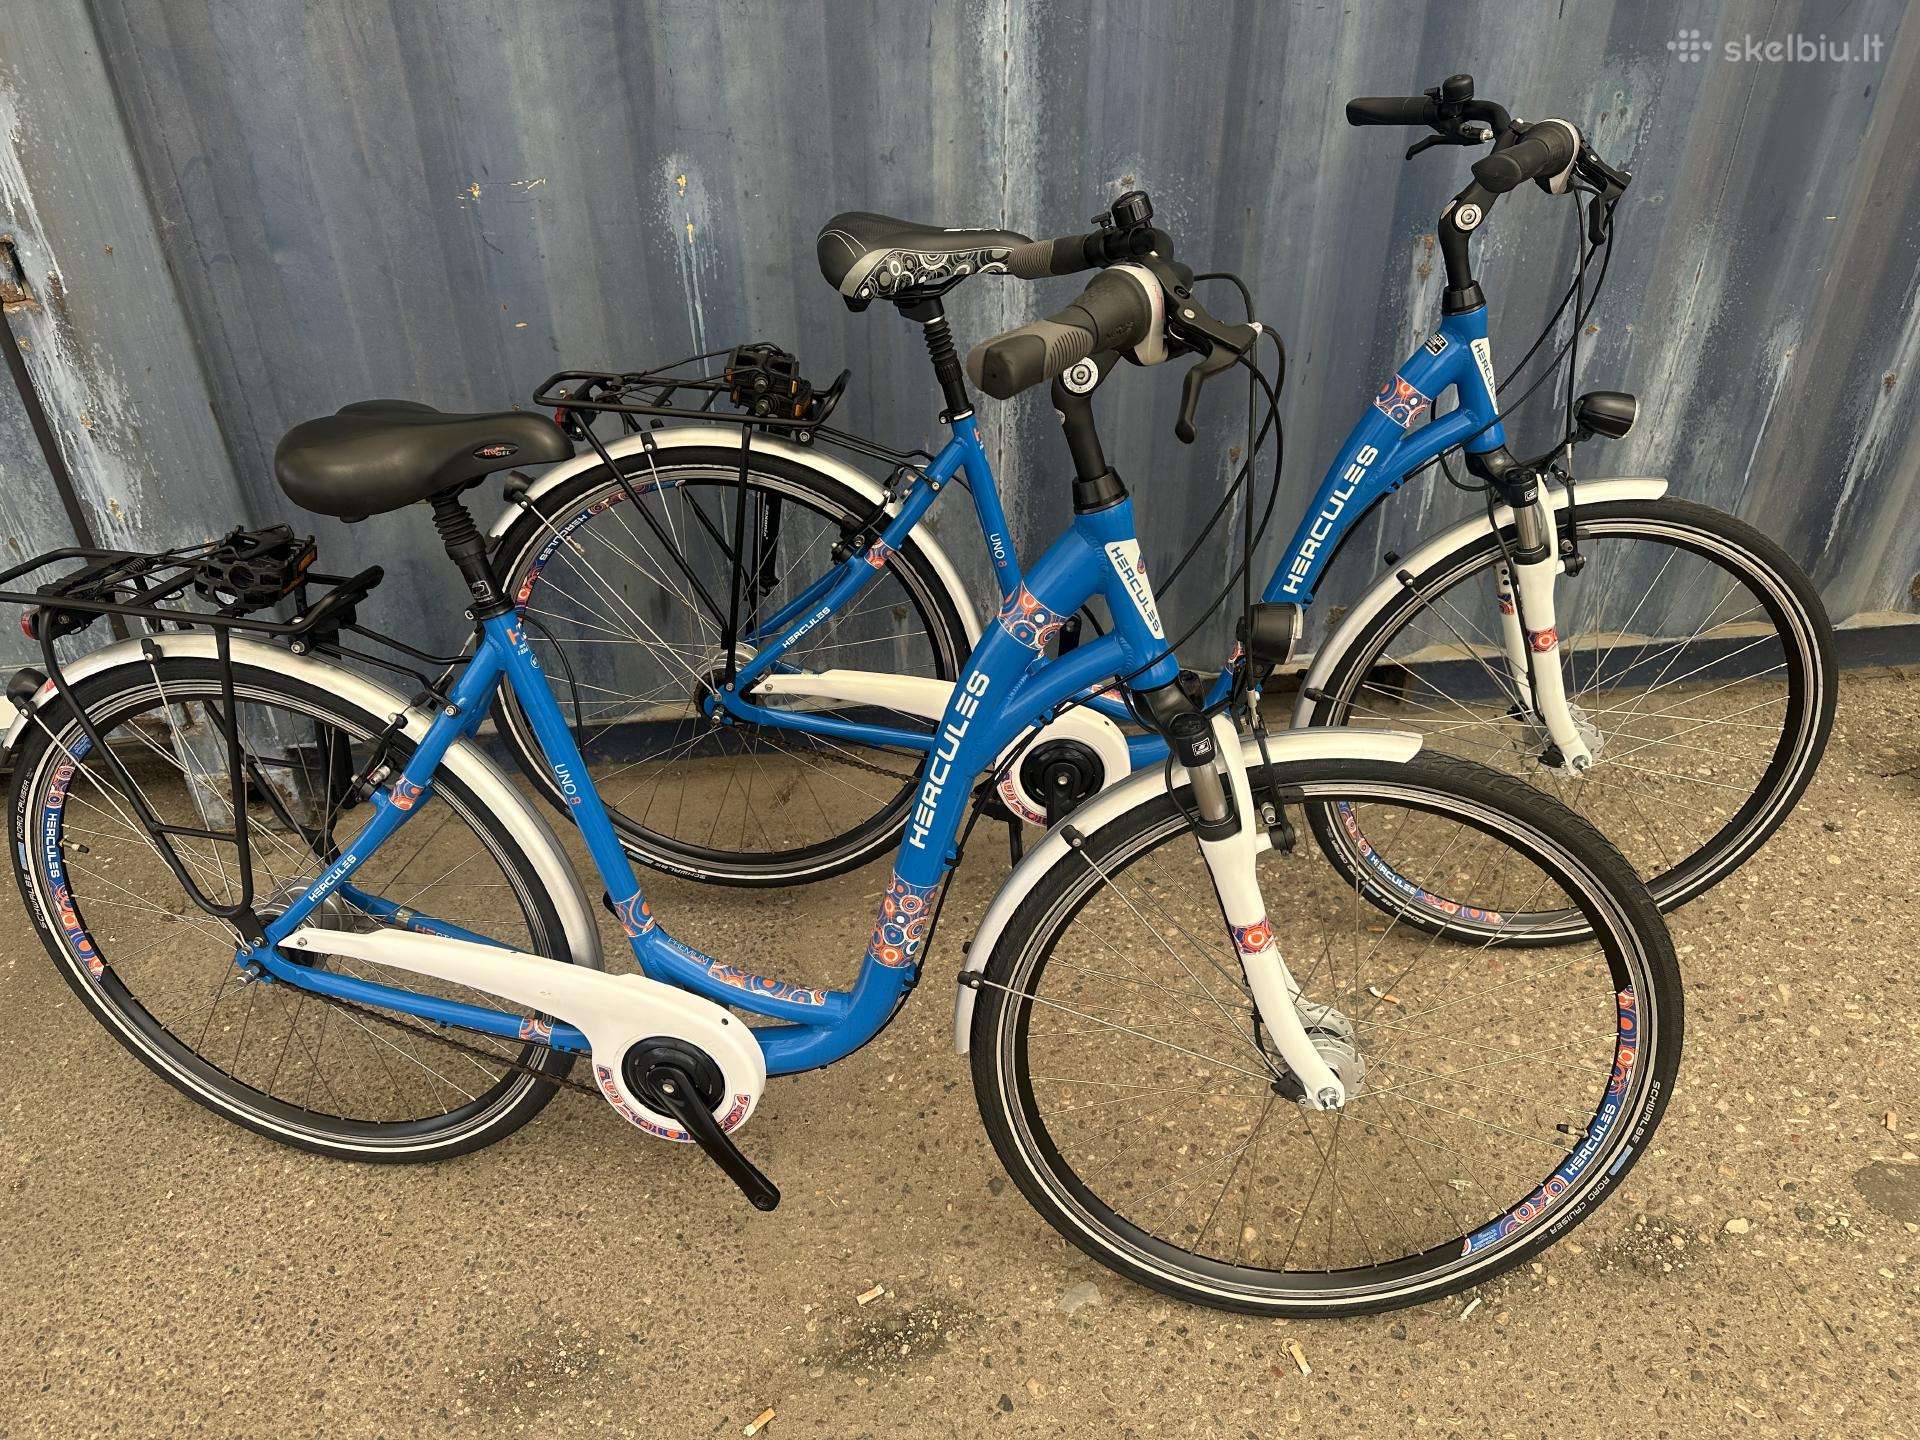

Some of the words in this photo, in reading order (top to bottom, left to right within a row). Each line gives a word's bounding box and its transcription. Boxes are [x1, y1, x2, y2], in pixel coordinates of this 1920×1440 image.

[1283, 444, 1378, 594] HERCULES
[990, 533, 1006, 559] UNO
[998, 560, 1007, 568] 8
[1111, 546, 1160, 632] HERCULES
[782, 606, 831, 649] HERCULES
[909, 670, 990, 850] HERCULES
[17, 780, 30, 814] CRUISER
[555, 763, 577, 795] UNO
[570, 796, 581, 805] 8
[16, 815, 24, 840] ROAD
[46, 813, 60, 878] HERCULES
[308, 855, 357, 902] HERCULES
[1370, 854, 1417, 896] HERCULES
[24, 873, 48, 930] SCHWALBE
[1632, 1080, 1661, 1144] SCHWALBE
[1565, 1103, 1616, 1176] HERCULES
[1588, 1176, 1610, 1201] ROAD
[1549, 1203, 1587, 1235] CRUISER
